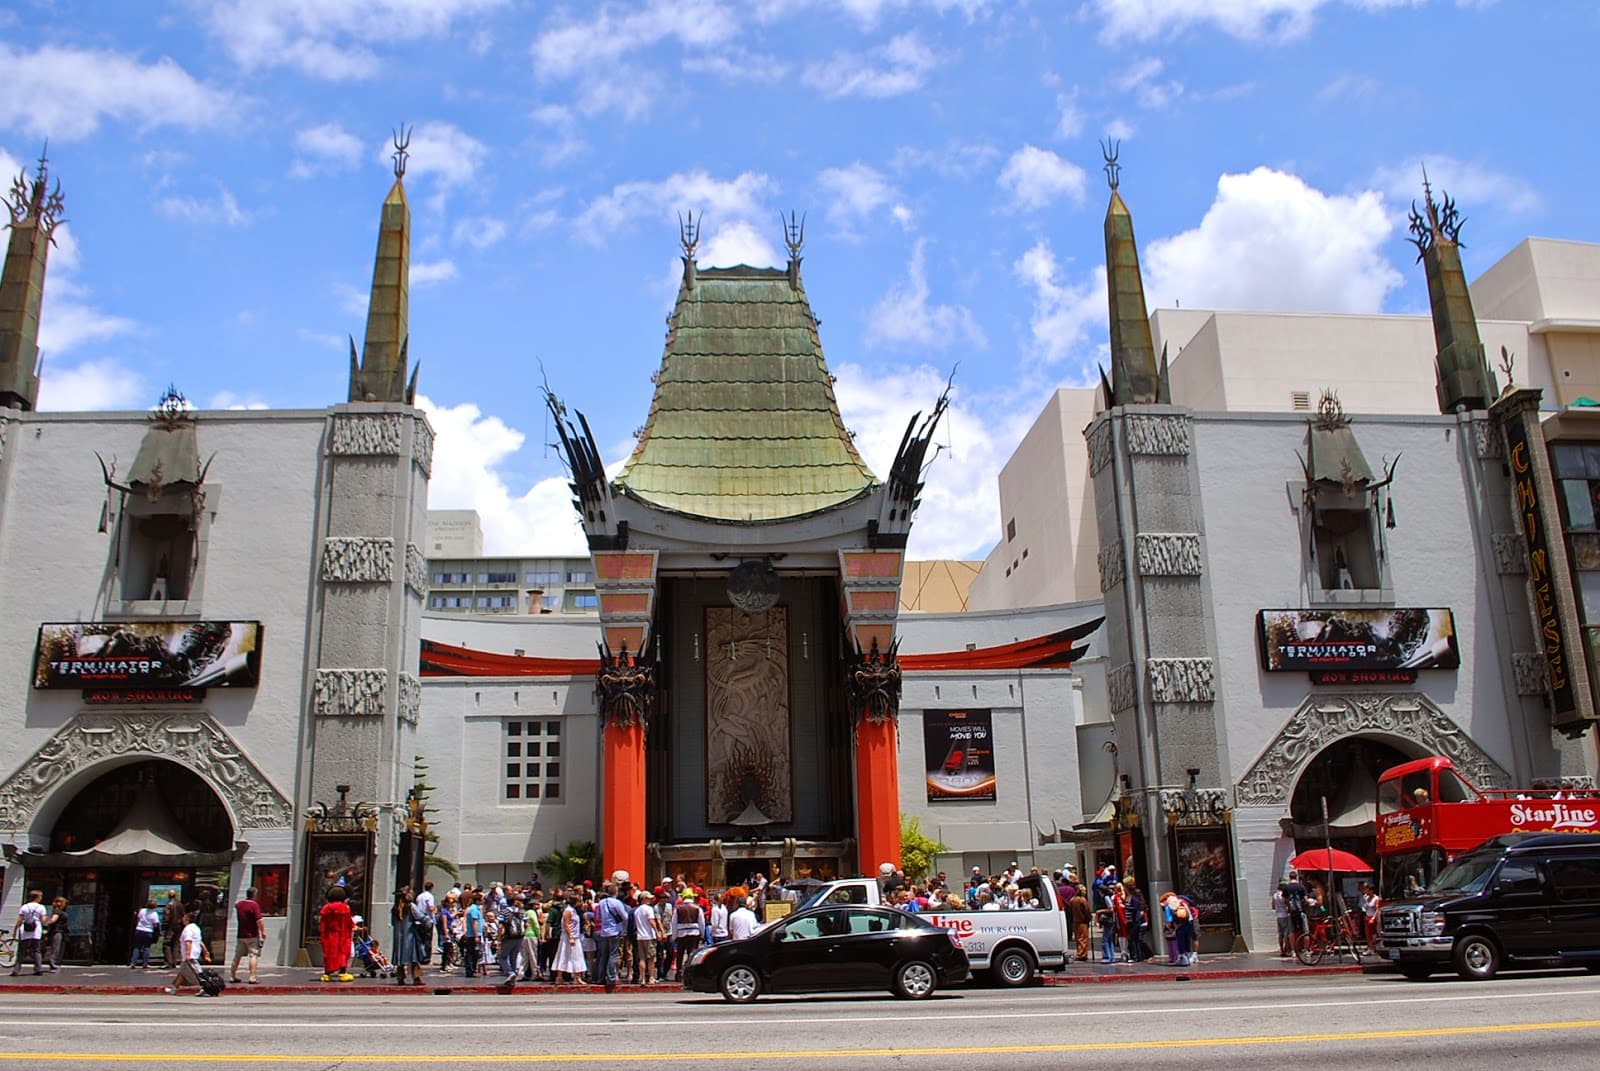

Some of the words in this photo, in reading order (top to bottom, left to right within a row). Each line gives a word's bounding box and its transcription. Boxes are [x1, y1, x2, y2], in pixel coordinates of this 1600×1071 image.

[1512, 442, 1565, 689] CHINESE
[1278, 645, 1377, 653] TERMINATOR
[50, 661, 162, 669] TERMINATOR
[949, 732, 972, 740] MOVE
[973, 731, 987, 739] YOU
